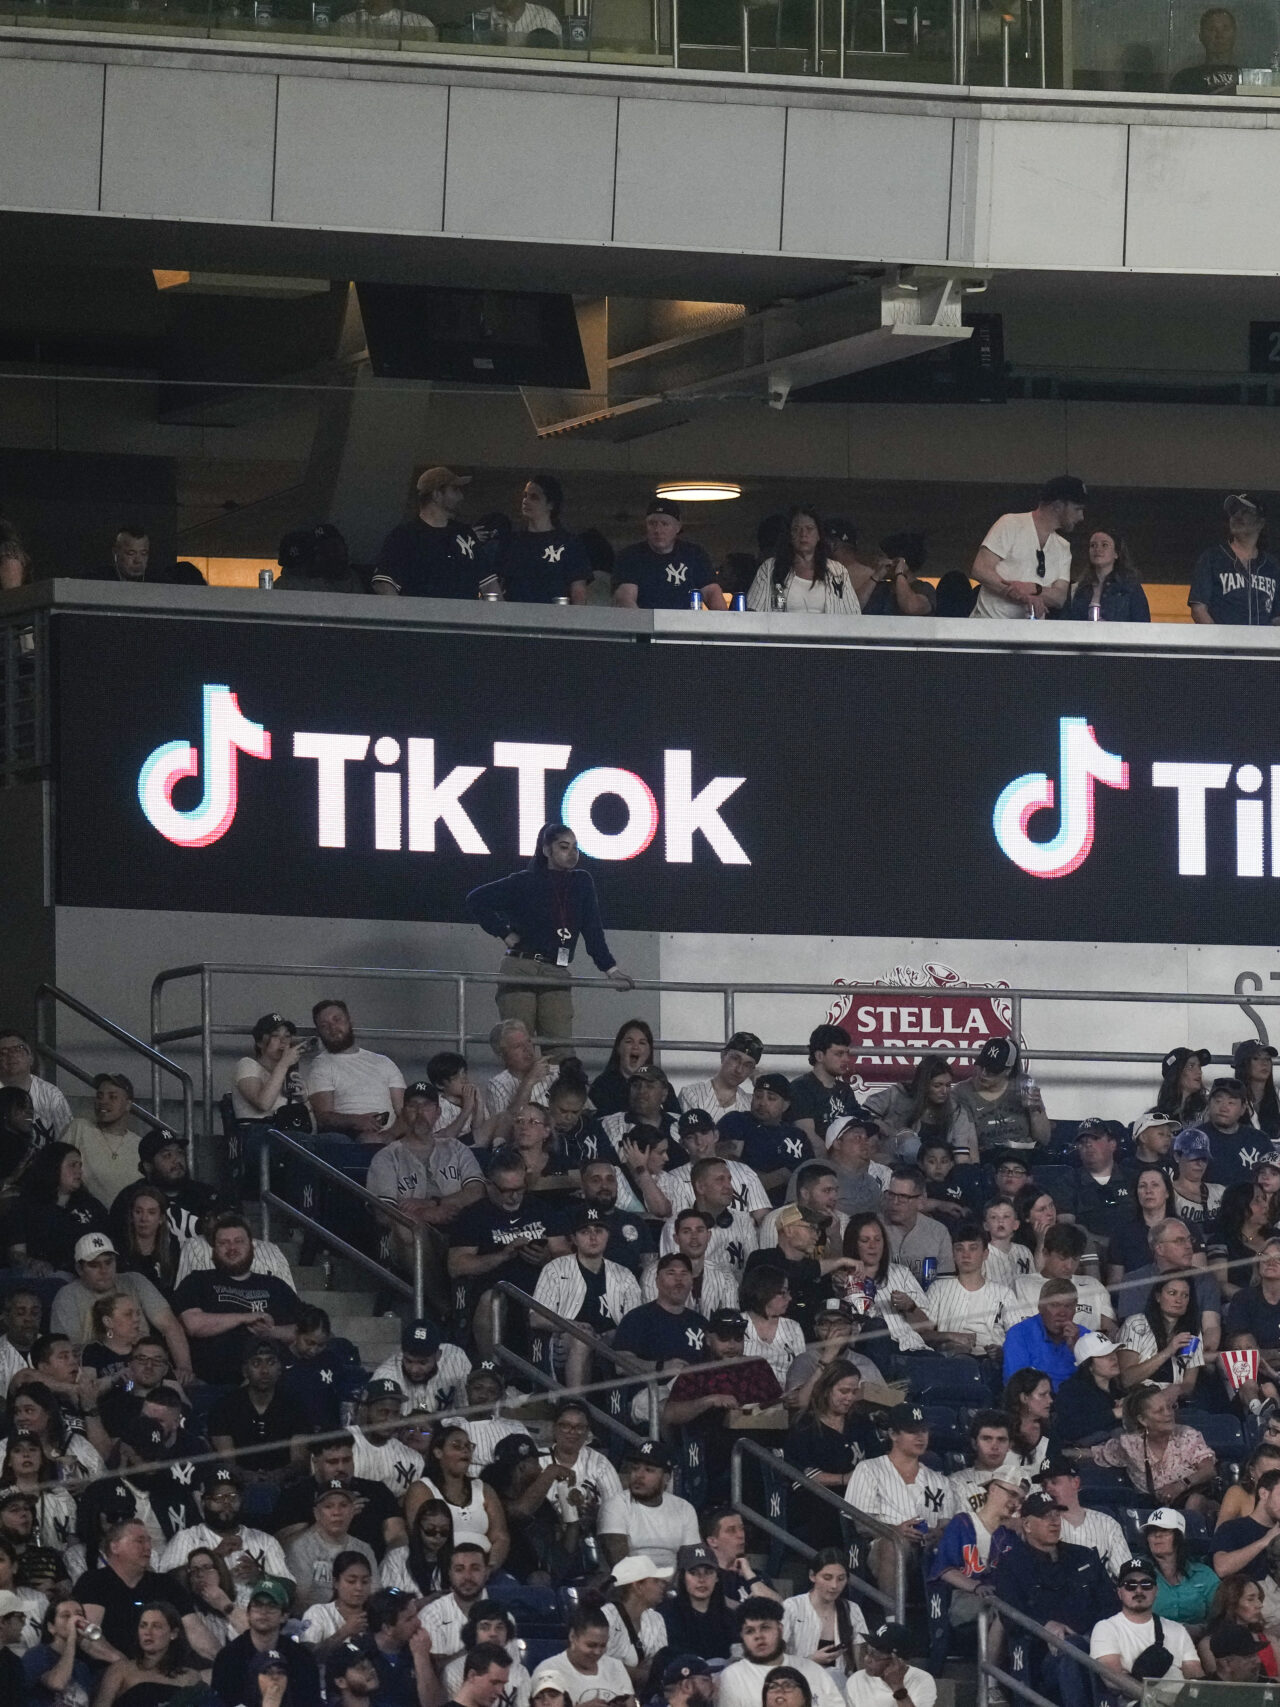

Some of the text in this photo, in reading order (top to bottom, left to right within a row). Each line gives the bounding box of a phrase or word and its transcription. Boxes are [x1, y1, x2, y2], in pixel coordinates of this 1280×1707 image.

[666, 562, 688, 586] NY
[1219, 571, 1277, 604] YANKEES
[293, 731, 751, 866] TikTok
[857, 1006, 990, 1034] STELLA
[784, 1138, 803, 1158] NY
[304, 1185, 313, 1207] NY
[397, 1173, 419, 1195] NEW
[456, 1286, 465, 1308] NY
[685, 1327, 705, 1350] NY
[320, 1369, 333, 1384] NY
[611, 1390, 620, 1414] NY
[689, 1443, 699, 1467] NY
[770, 1494, 780, 1516] NY
[924, 1486, 944, 1512] NY
[848, 1545, 860, 1568] NY
[931, 1594, 941, 1619] NY
[1012, 1647, 1024, 1671] NY
